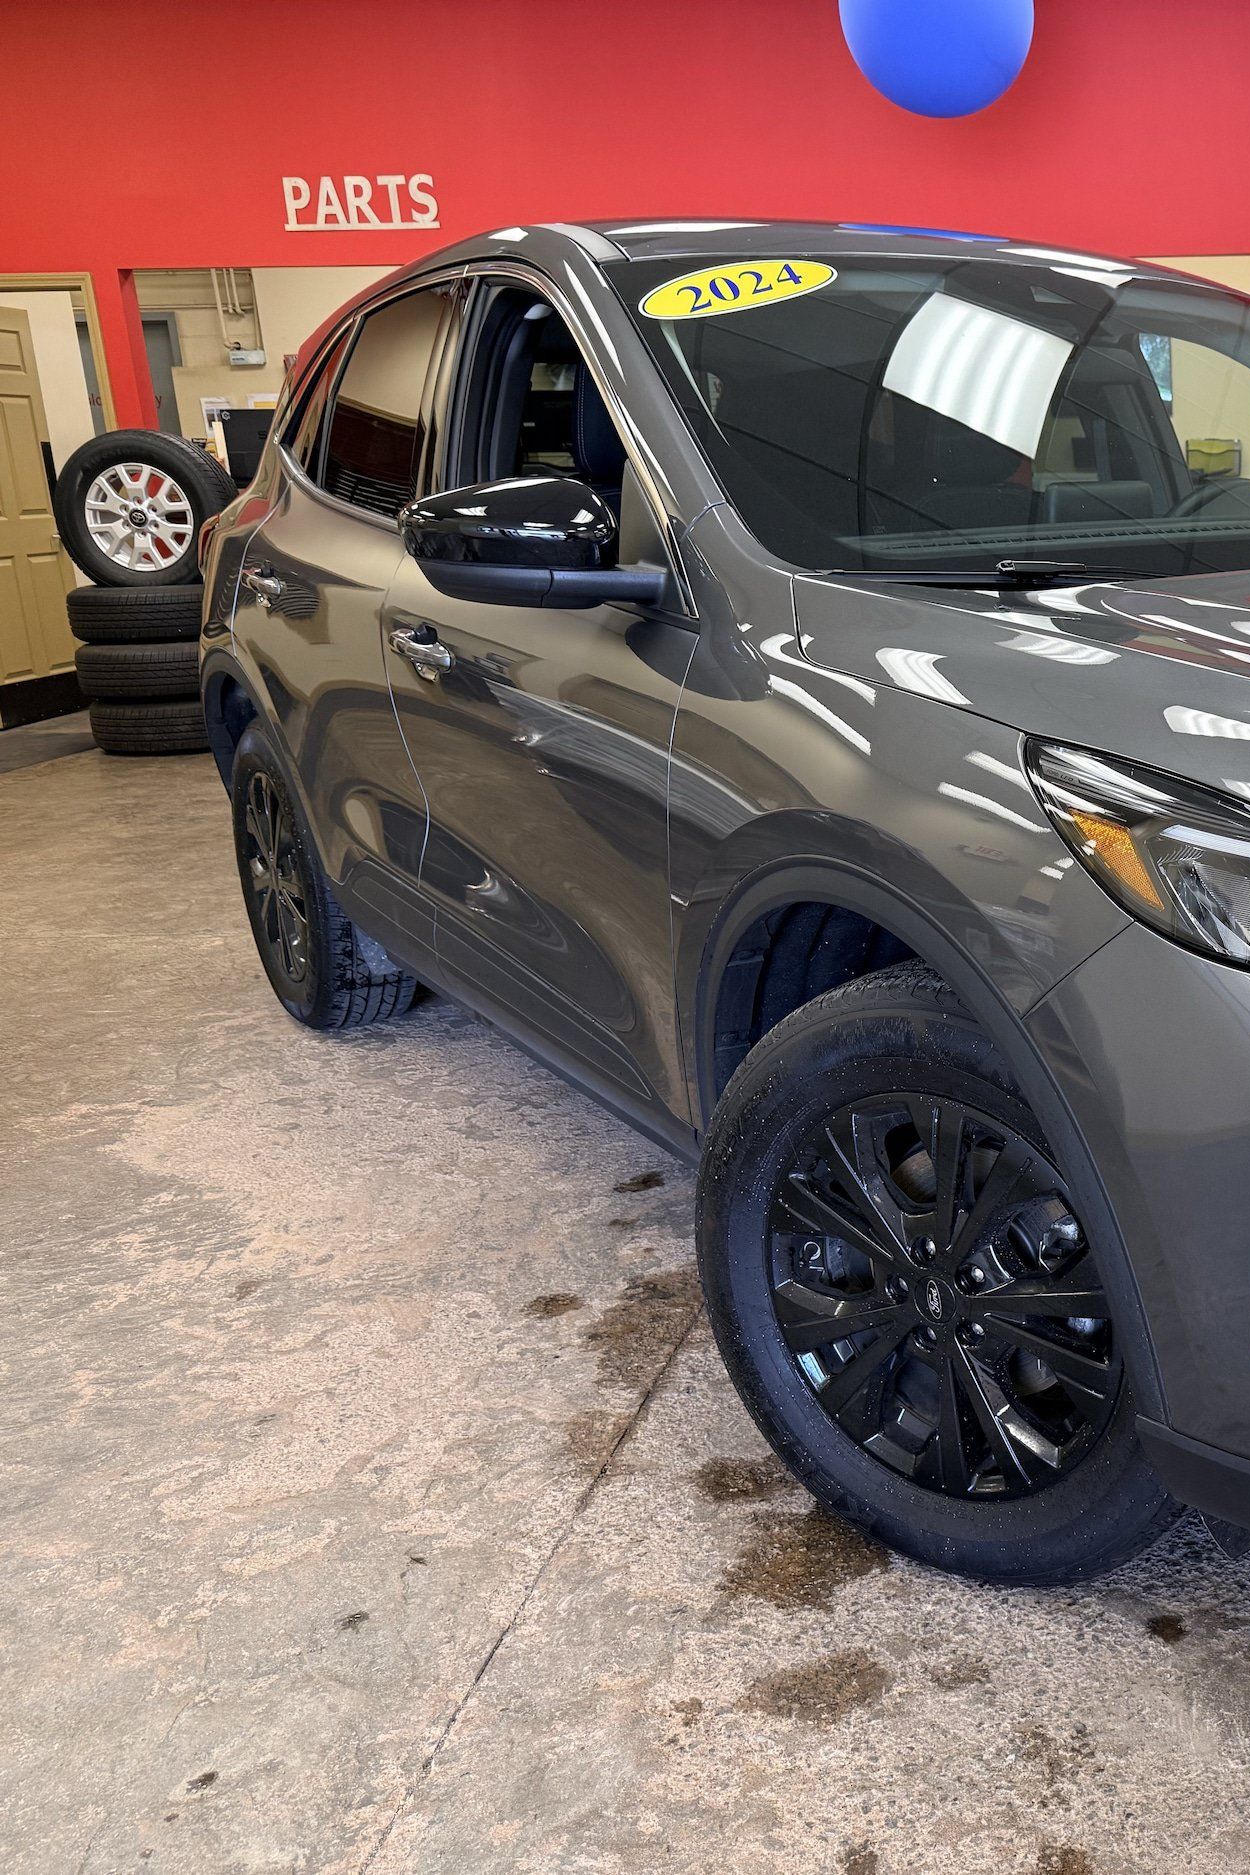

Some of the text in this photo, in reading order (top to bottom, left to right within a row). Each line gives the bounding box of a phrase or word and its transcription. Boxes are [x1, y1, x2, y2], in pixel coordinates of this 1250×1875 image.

[282, 173, 440, 230] PARTS
[677, 264, 802, 313] 2024
[928, 1287, 941, 1313] Ford
